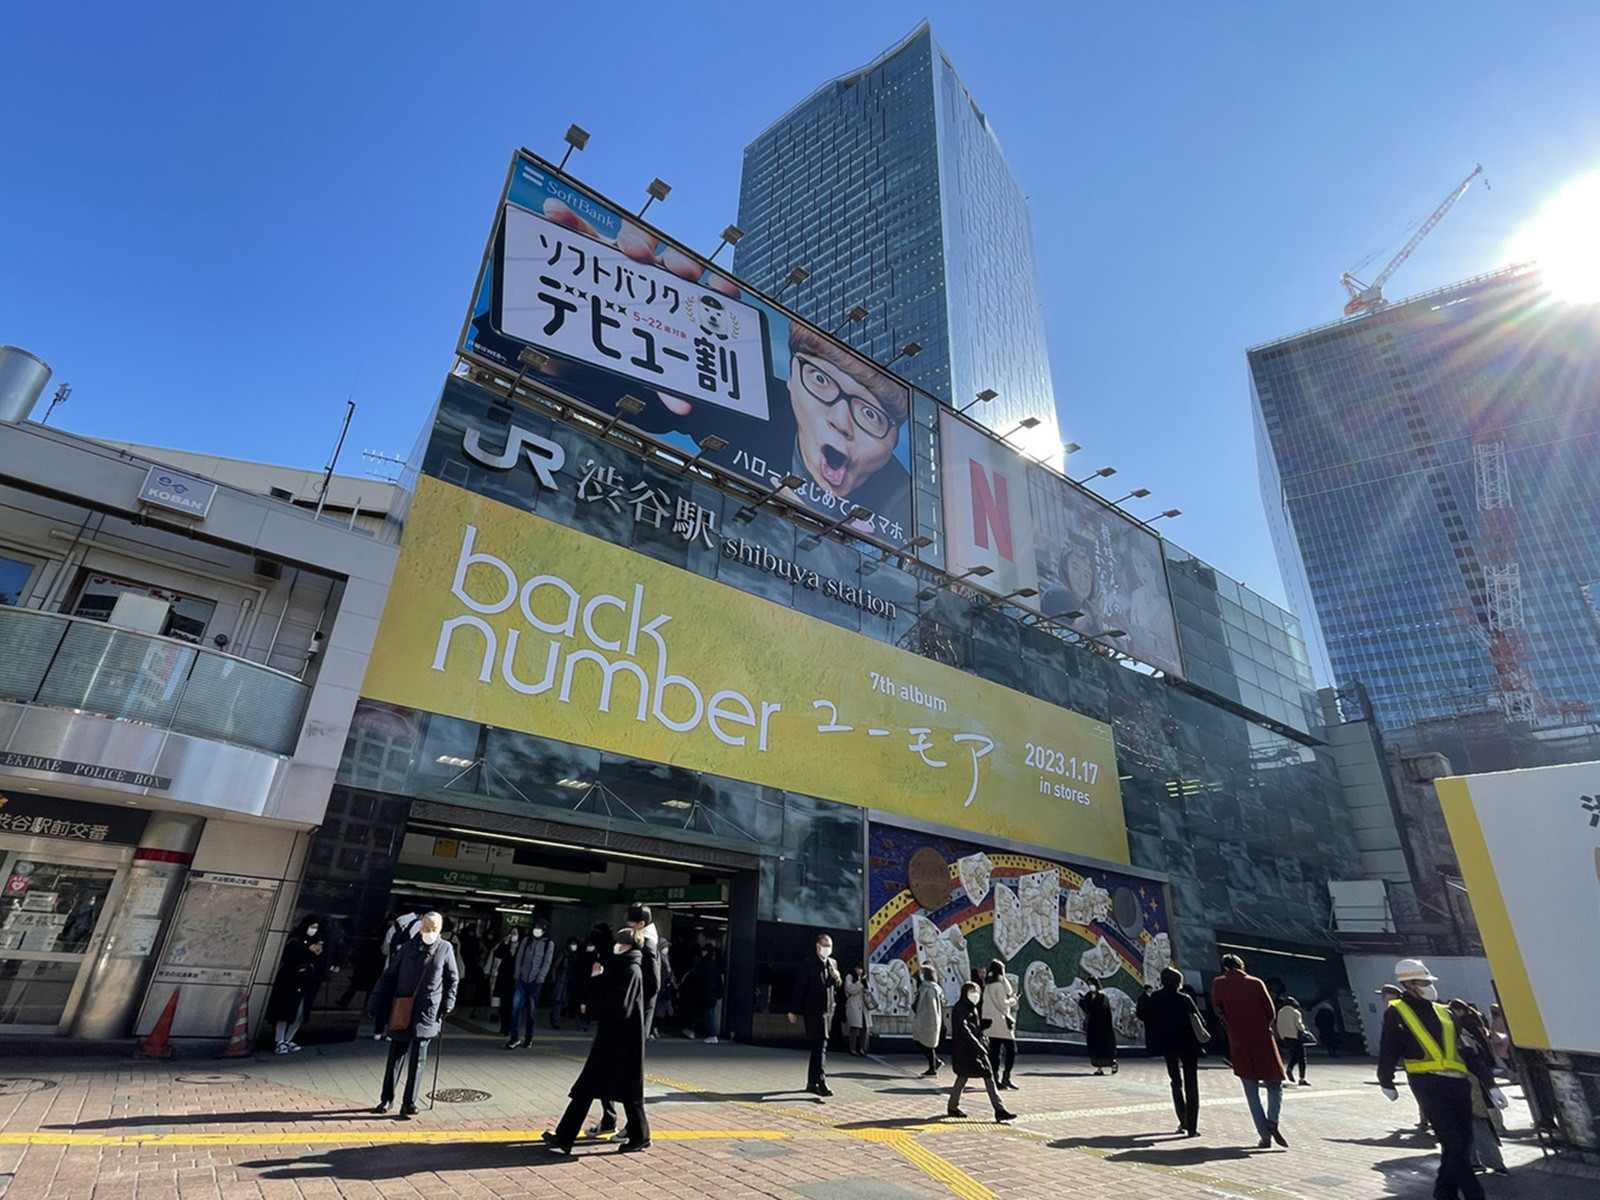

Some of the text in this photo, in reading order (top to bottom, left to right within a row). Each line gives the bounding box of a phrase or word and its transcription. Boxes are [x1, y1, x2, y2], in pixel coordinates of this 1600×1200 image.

[546, 180, 616, 230] SoftBank
[540, 235, 679, 313] ソフトバンク
[537, 276, 740, 400] デビュー割
[148, 488, 203, 510] KOBAN
[463, 425, 714, 548] JR 渋谷駅
[968, 457, 1014, 563] N
[451, 524, 673, 656] back
[726, 538, 896, 619] shibuya station
[431, 615, 781, 751] number
[870, 671, 948, 713] 7th album
[73, 763, 126, 782] POLICE
[134, 774, 160, 788] BOX
[812, 699, 995, 808] ユーモア
[1025, 742, 1099, 785] 2023.1.17
[1039, 776, 1091, 806] in stores
